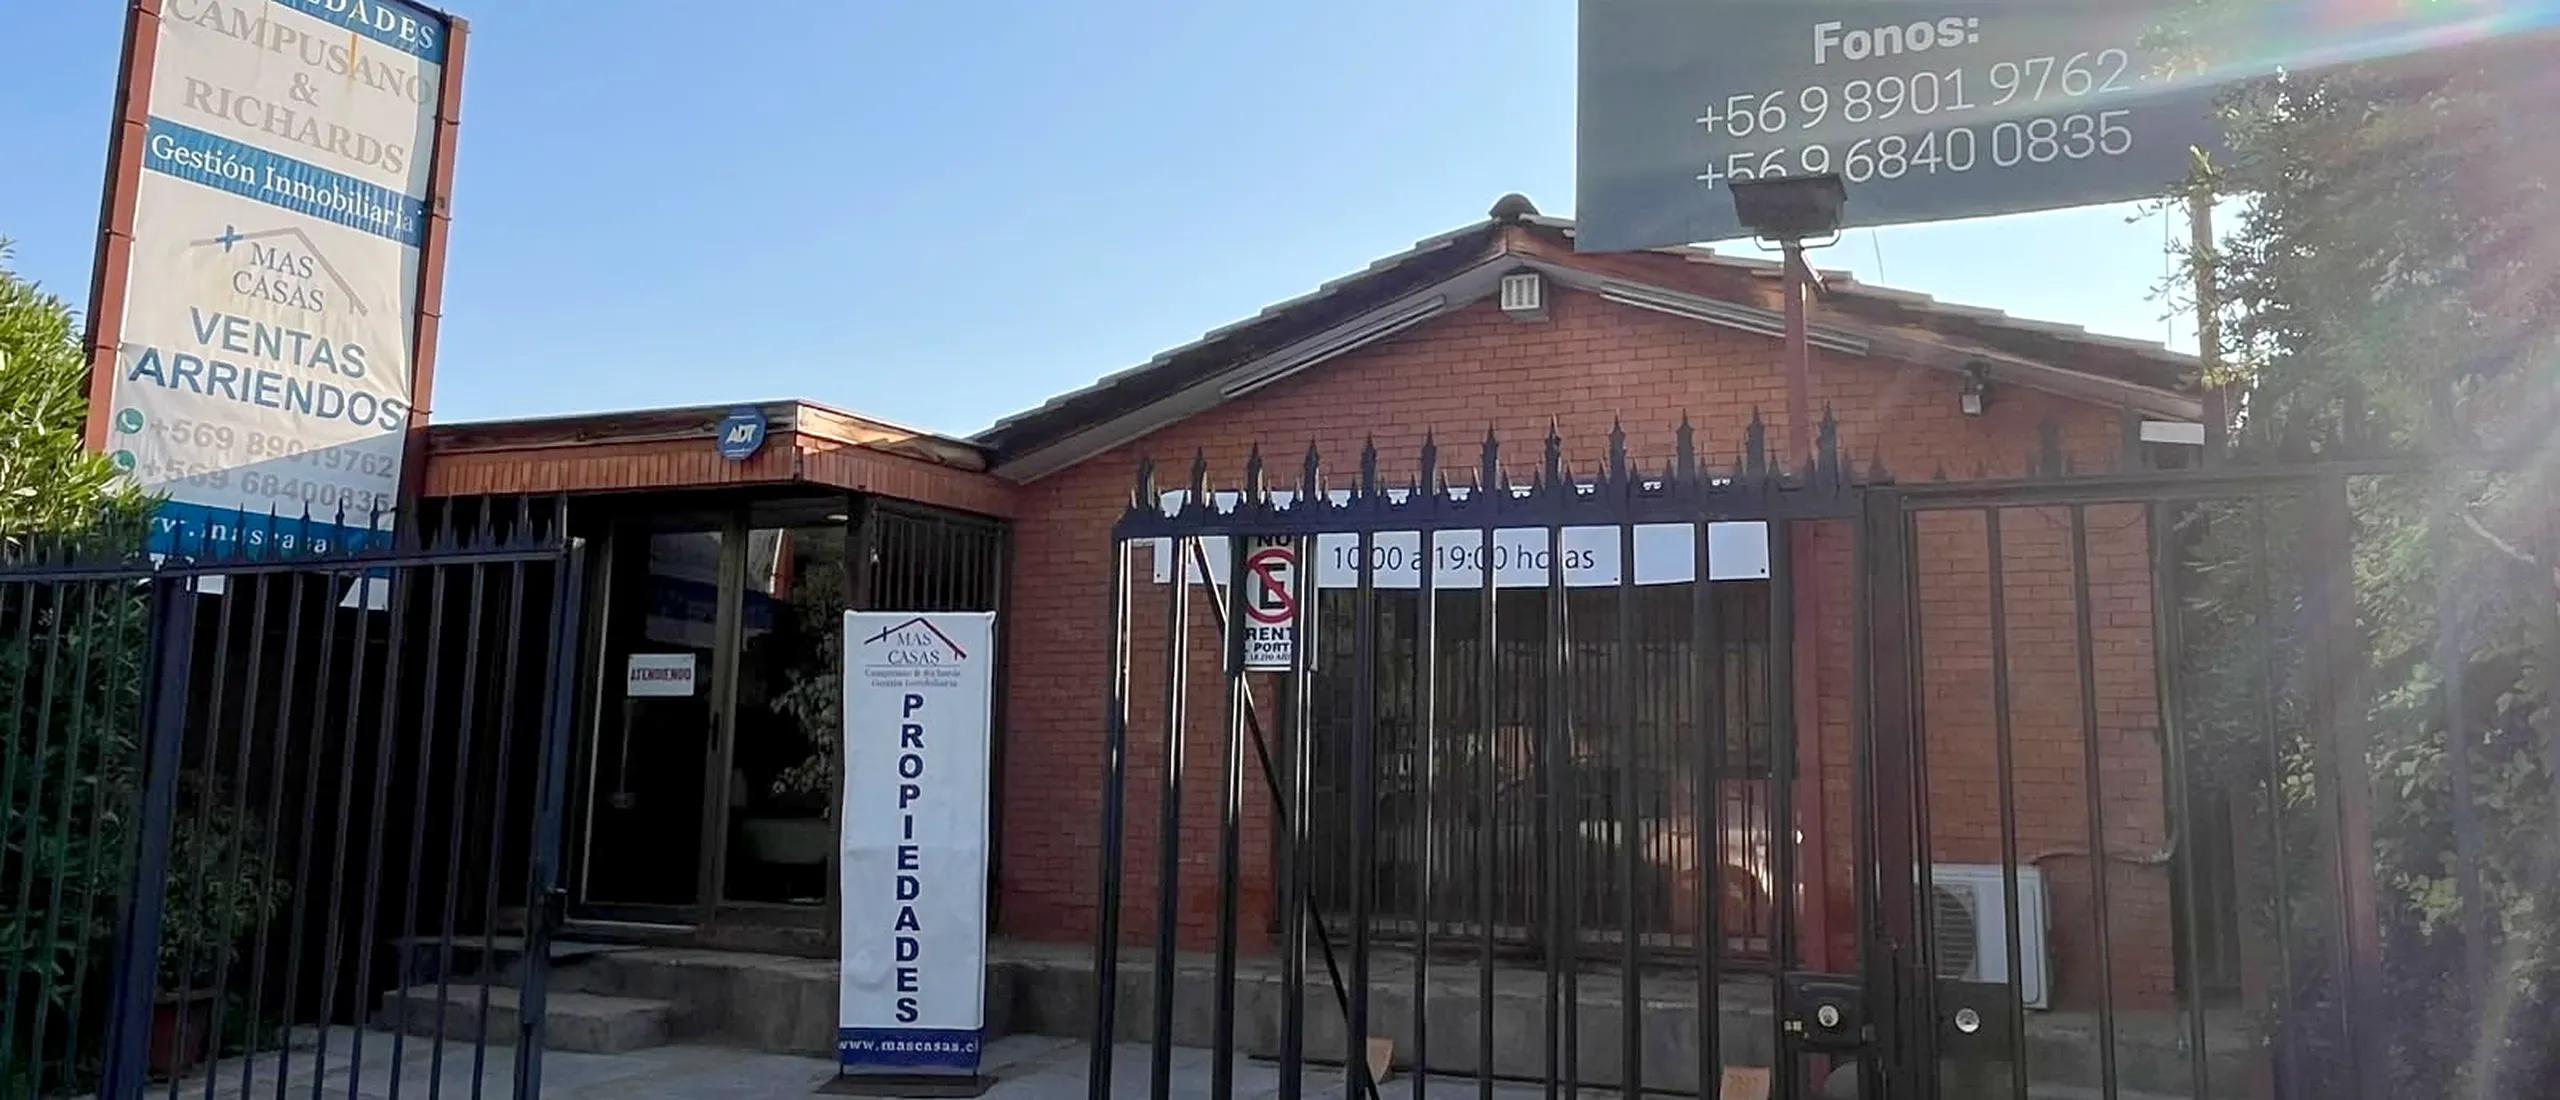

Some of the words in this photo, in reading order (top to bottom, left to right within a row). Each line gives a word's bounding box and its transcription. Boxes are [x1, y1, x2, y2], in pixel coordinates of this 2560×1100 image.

[169, 0, 432, 104] CAMPUSANO
[1813, 14, 1980, 65] Fonos:
[288, 73, 318, 107] &
[1696, 90, 1787, 137] +56
[1799, 86, 1829, 129] 9
[1843, 67, 1975, 123] 8901
[1989, 48, 2131, 106] 9762
[184, 76, 404, 175] RICHARDS
[1800, 144, 1830, 174] 9
[1845, 127, 1976, 184] 6840
[1991, 109, 2132, 168] 0835
[152, 134, 256, 186] Gestión
[265, 164, 414, 233] Inmobiliaria
[249, 241, 314, 279] MAS
[232, 270, 324, 313] CASAS
[190, 307, 366, 379] VENTAS
[128, 346, 402, 432] ARRIENDOS
[151, 418, 235, 450] +569
[246, 431, 394, 479] 89019762
[725, 423, 758, 444] ADT
[142, 456, 232, 489] +569
[241, 471, 390, 513] 68400835
[1517, 544, 1594, 569] hoas
[887, 649, 941, 665] CASAS
[896, 632, 932, 647] MAS
[893, 693, 925, 1024] PROPIEDADES
